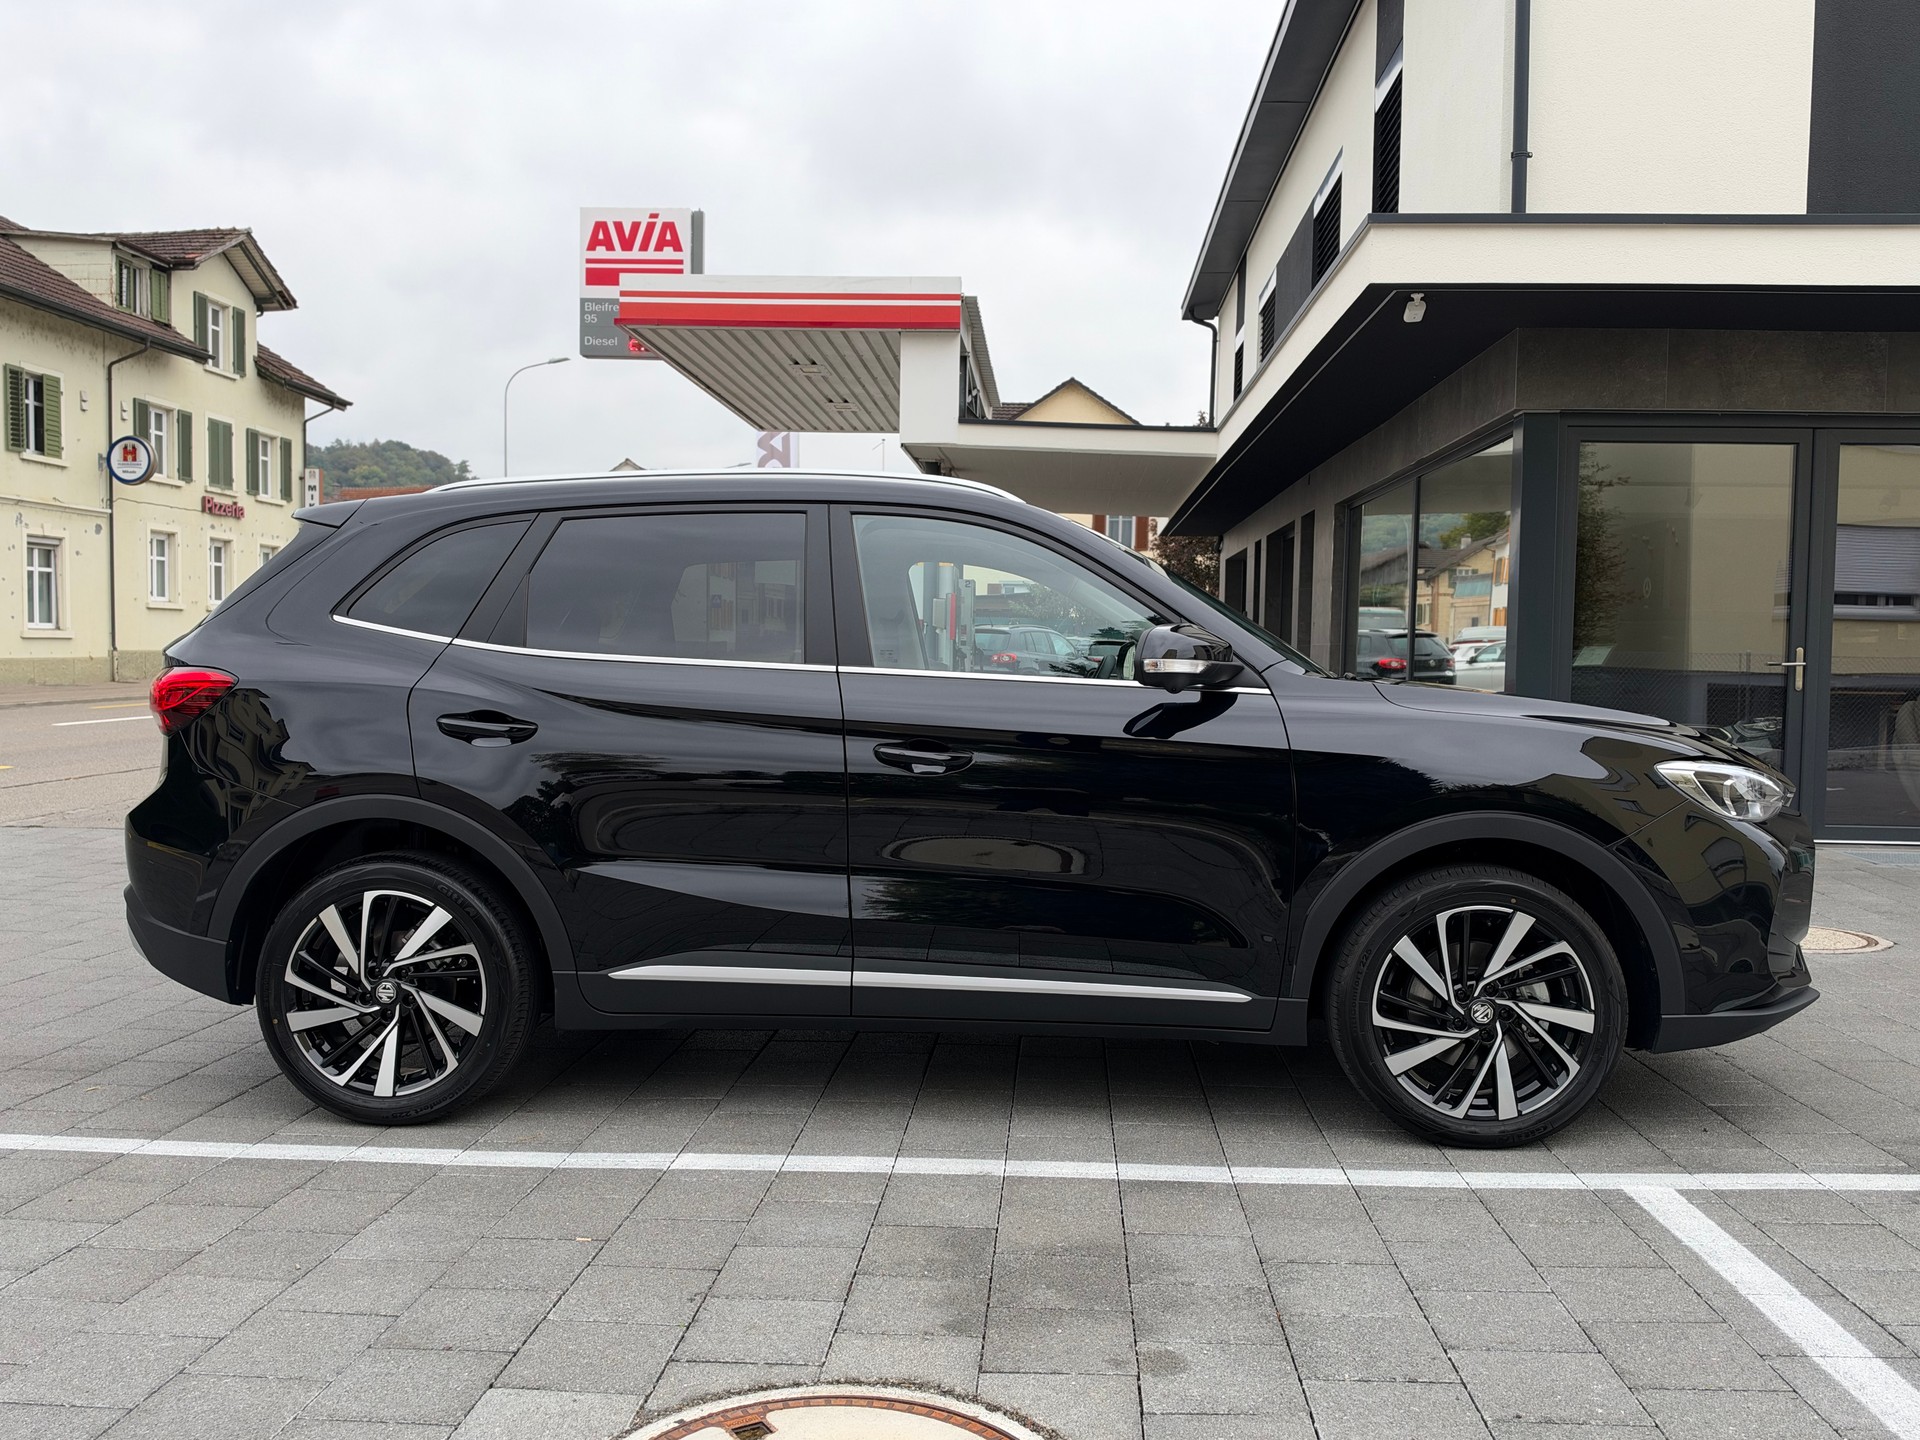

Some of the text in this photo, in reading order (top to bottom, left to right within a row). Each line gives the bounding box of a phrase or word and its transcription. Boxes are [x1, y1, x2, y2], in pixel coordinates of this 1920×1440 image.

[584, 302, 619, 312] Bleifre
[584, 314, 598, 324] 95
[584, 336, 618, 346] Diesel
[204, 496, 245, 518] Pizzeria
[964, 580, 971, 588] 2
[1472, 1003, 1492, 1022] MG
